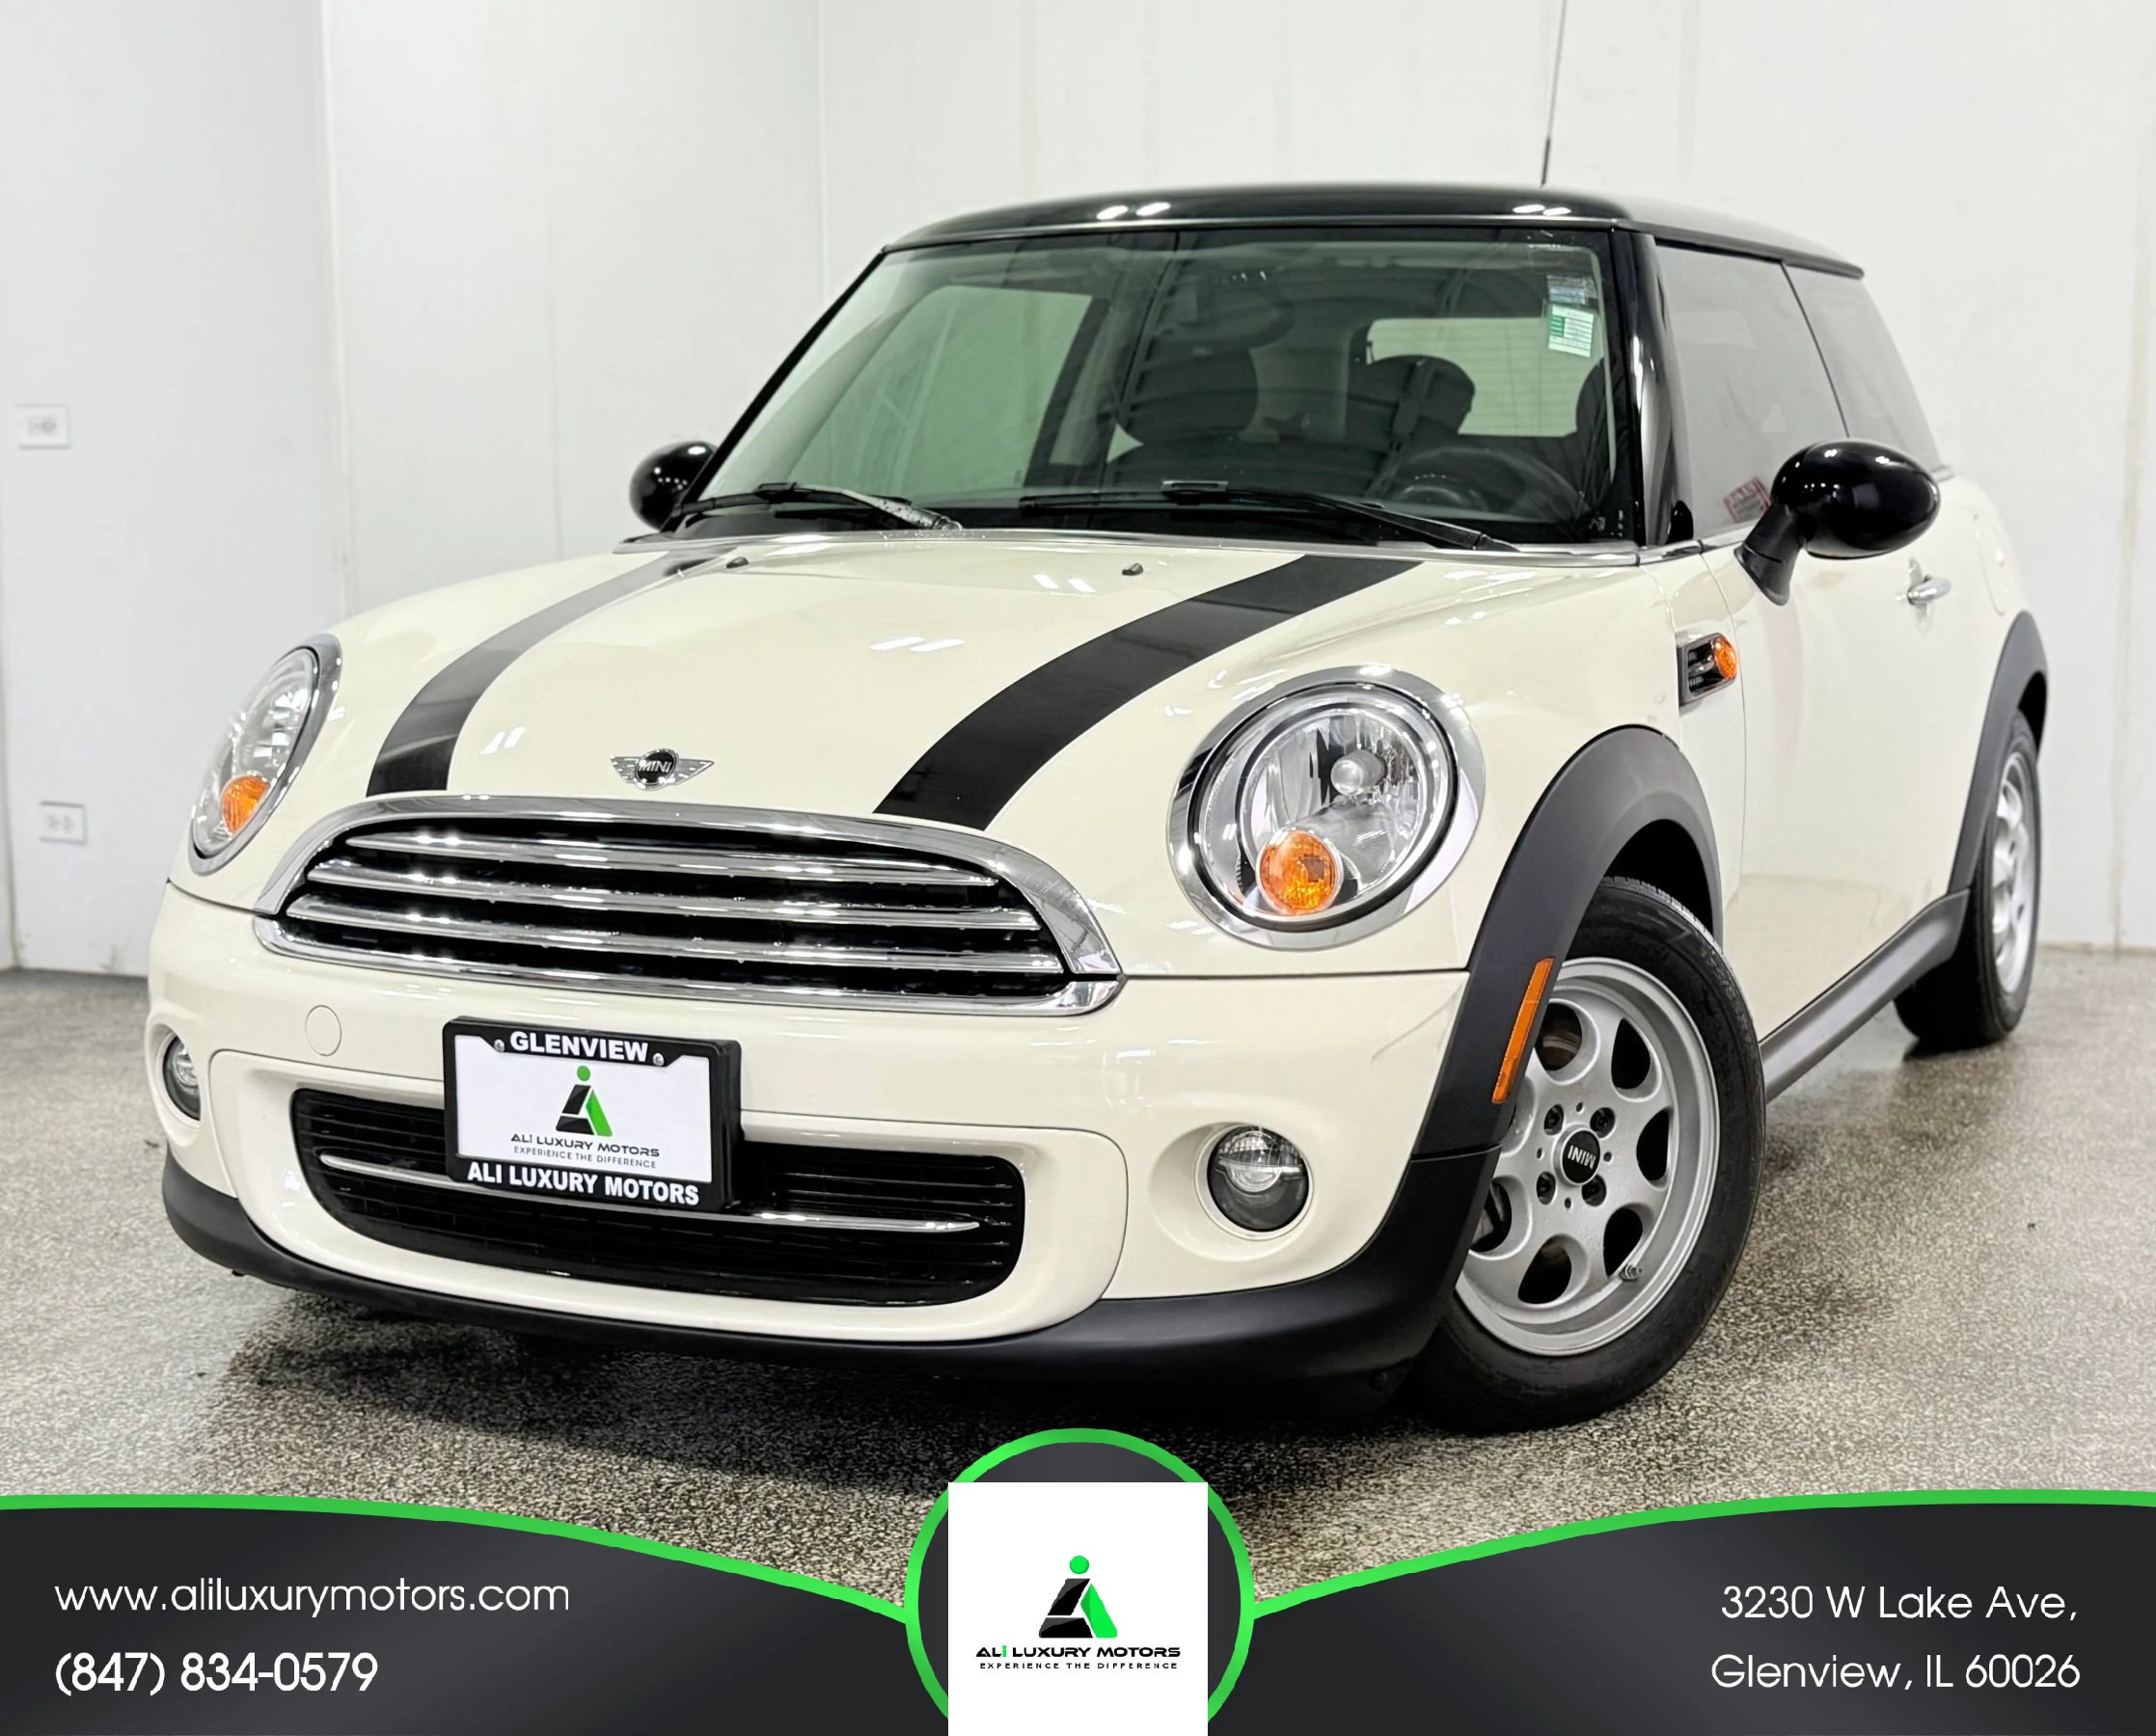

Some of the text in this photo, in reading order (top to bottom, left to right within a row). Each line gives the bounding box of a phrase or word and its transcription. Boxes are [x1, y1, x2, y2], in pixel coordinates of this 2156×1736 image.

[639, 760, 673, 773] MINI
[509, 1031, 649, 1063] GLENVIEW
[513, 1145, 657, 1169] EXPERIENCE THE DIFFERENCE
[536, 1135, 593, 1151] LUXURY
[597, 1142, 660, 1157] MOTORS
[1567, 1145, 1597, 1170] MINI
[467, 1161, 700, 1206] ALI LUXURY MOTORS
